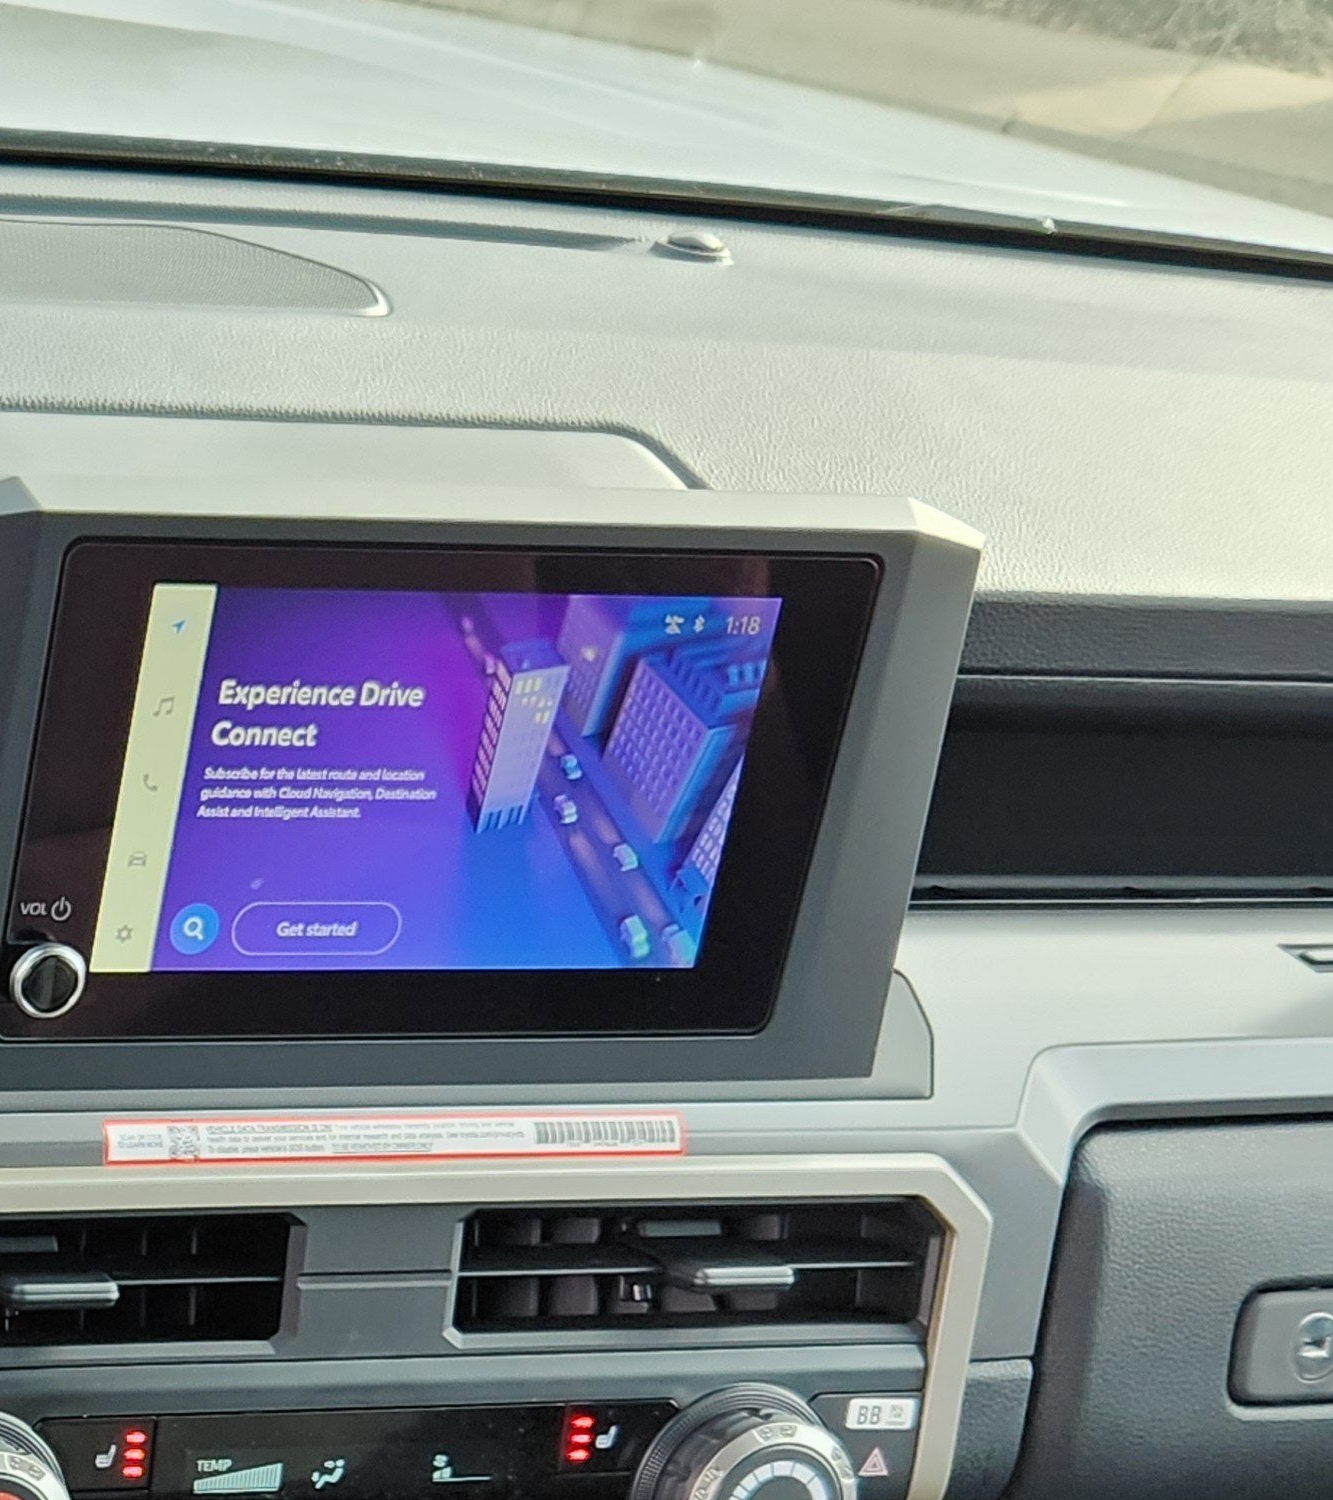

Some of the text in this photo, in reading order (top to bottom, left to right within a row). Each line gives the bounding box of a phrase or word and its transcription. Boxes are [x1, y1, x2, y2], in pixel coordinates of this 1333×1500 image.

[725, 615, 762, 635] 1:18
[218, 678, 426, 710] Experience Drive
[211, 719, 319, 748] Connect
[203, 766, 426, 781] Subscribe for the latest route and location
[200, 786, 253, 801] guidance
[253, 786, 277, 800] with
[278, 787, 312, 800] Cloud
[375, 788, 437, 801] Destination
[196, 804, 230, 818] Assist
[230, 805, 253, 818] and
[254, 805, 309, 820] Intelligent
[19, 901, 48, 917] VOL
[276, 920, 359, 939] Get started
[195, 1458, 233, 1473] TEMP
